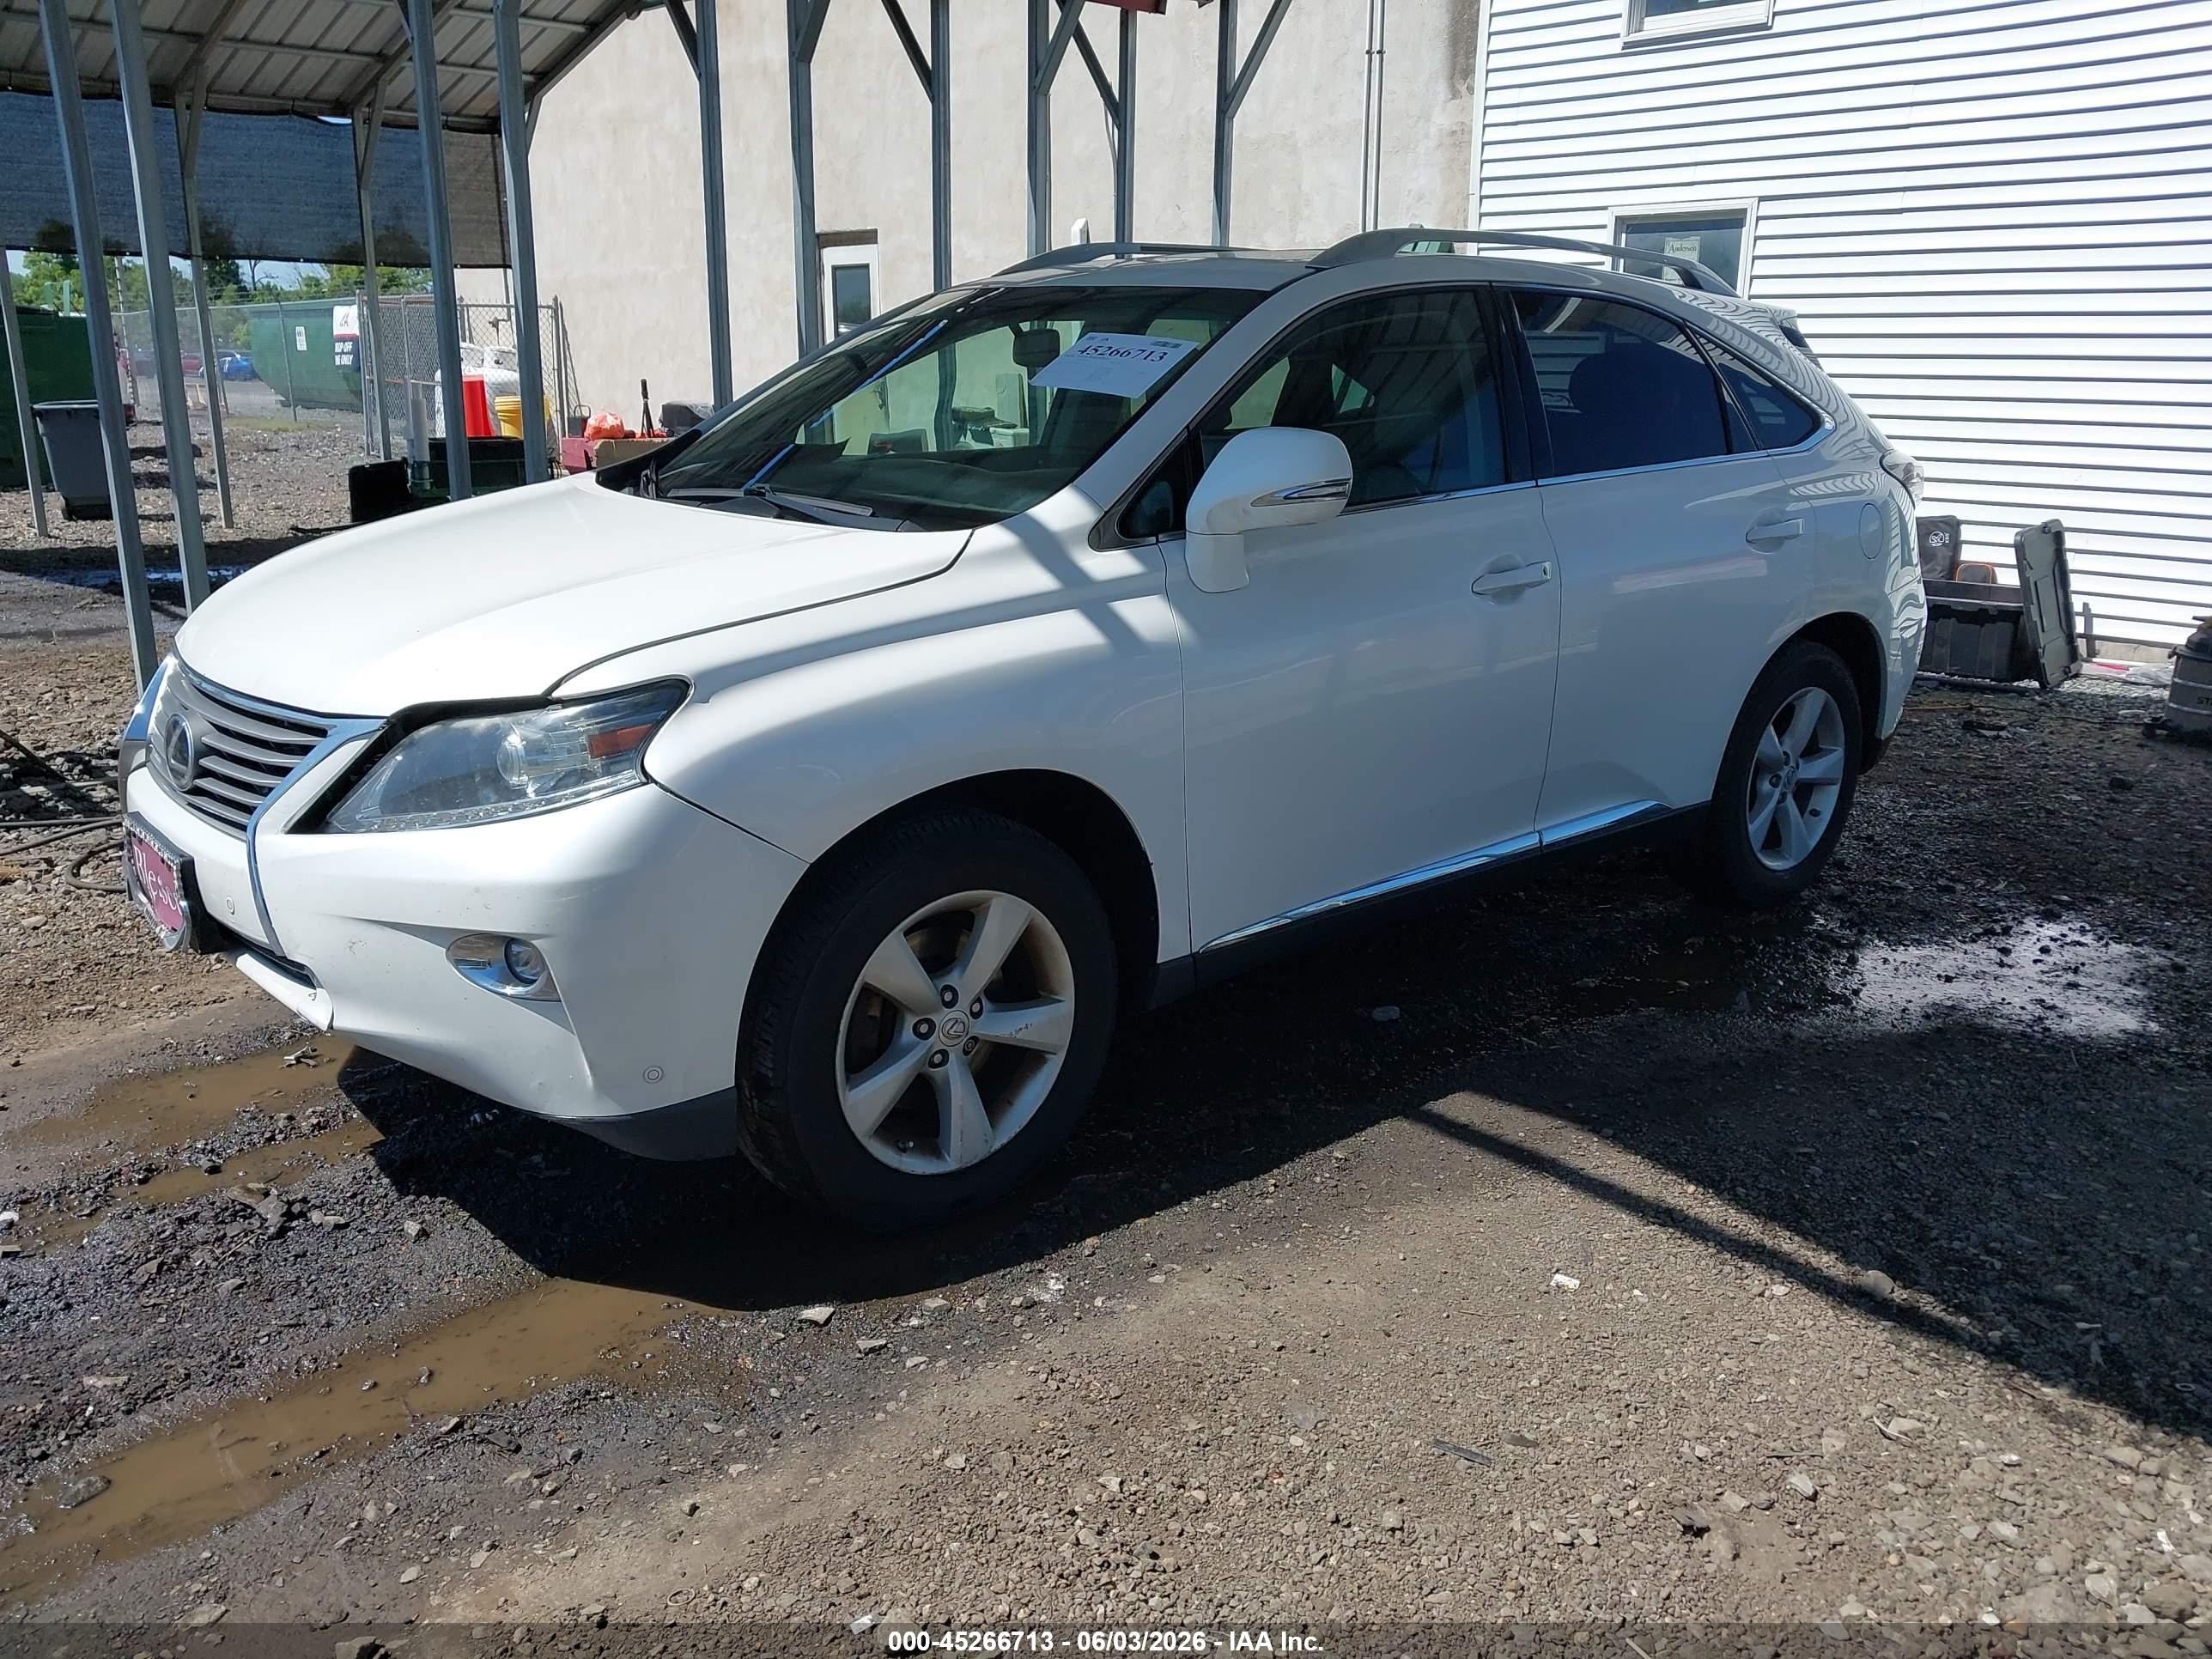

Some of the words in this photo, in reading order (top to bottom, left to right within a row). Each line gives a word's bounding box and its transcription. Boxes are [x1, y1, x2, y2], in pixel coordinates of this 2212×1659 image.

[343, 341, 353, 353] OFF
[341, 354, 354, 365] ONLY
[1079, 345, 1169, 362] 45266713
